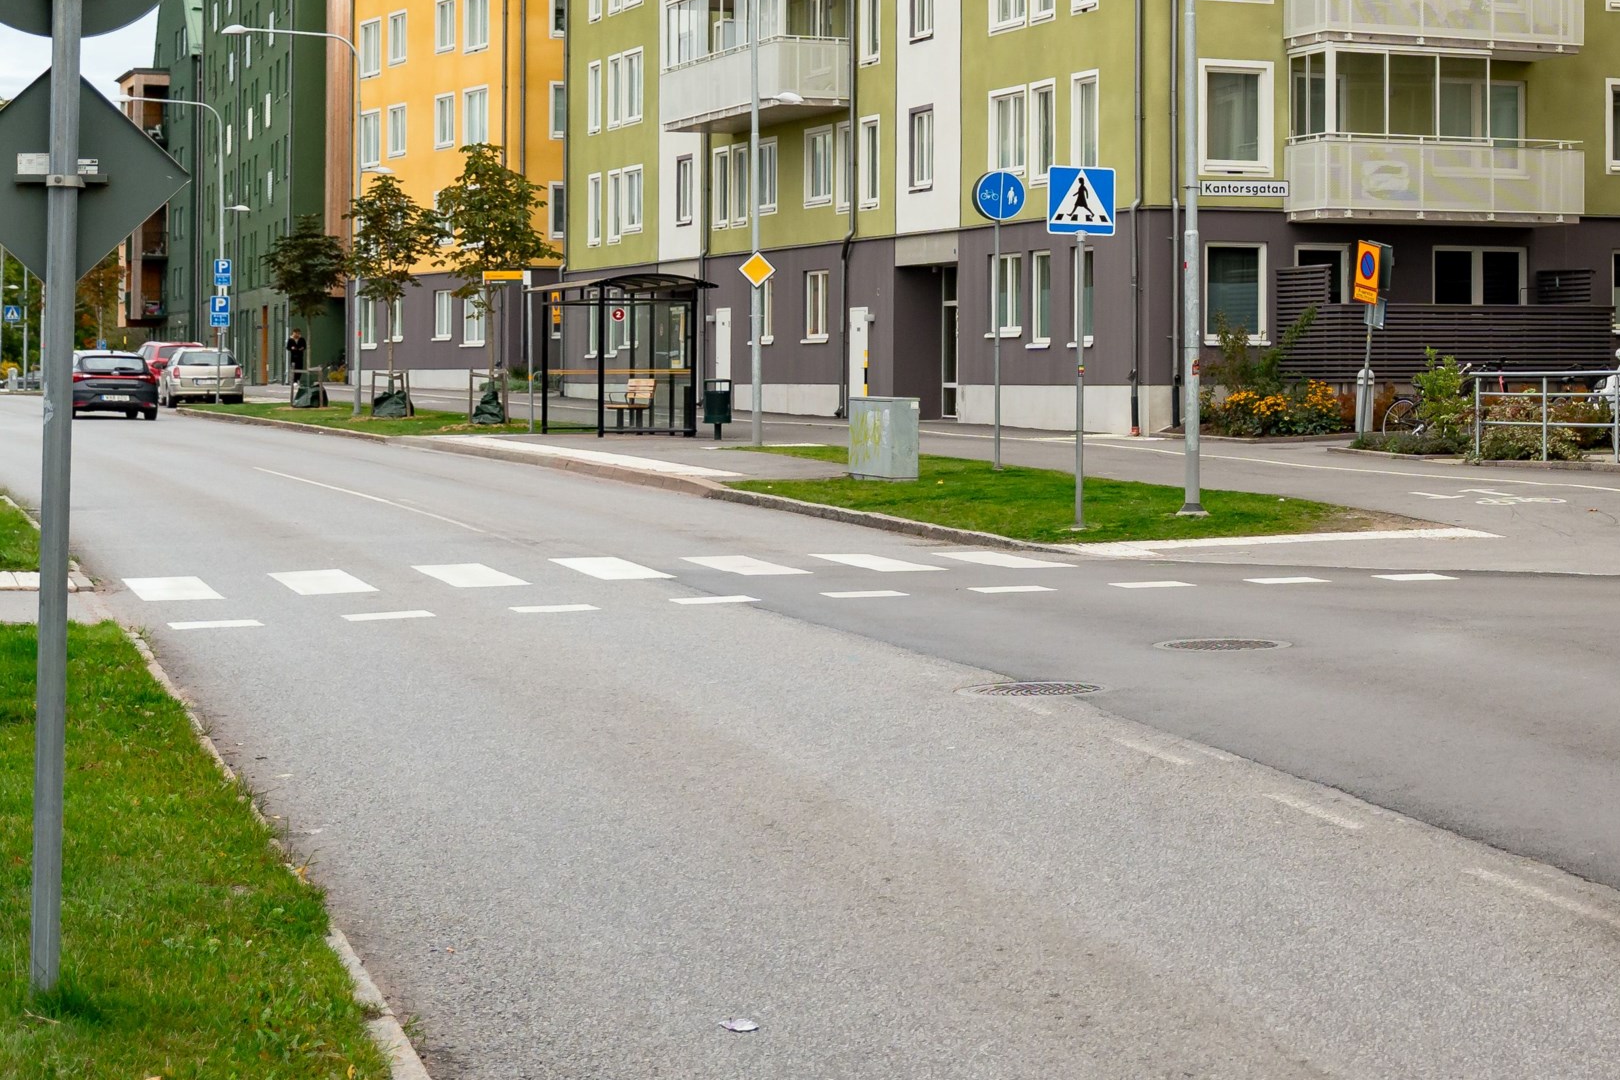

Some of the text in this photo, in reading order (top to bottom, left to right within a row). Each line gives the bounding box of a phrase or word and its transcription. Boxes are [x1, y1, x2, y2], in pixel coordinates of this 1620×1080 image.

[1205, 183, 1286, 196] Kantorsgatan
[218, 261, 229, 273] P
[215, 298, 227, 312] P
